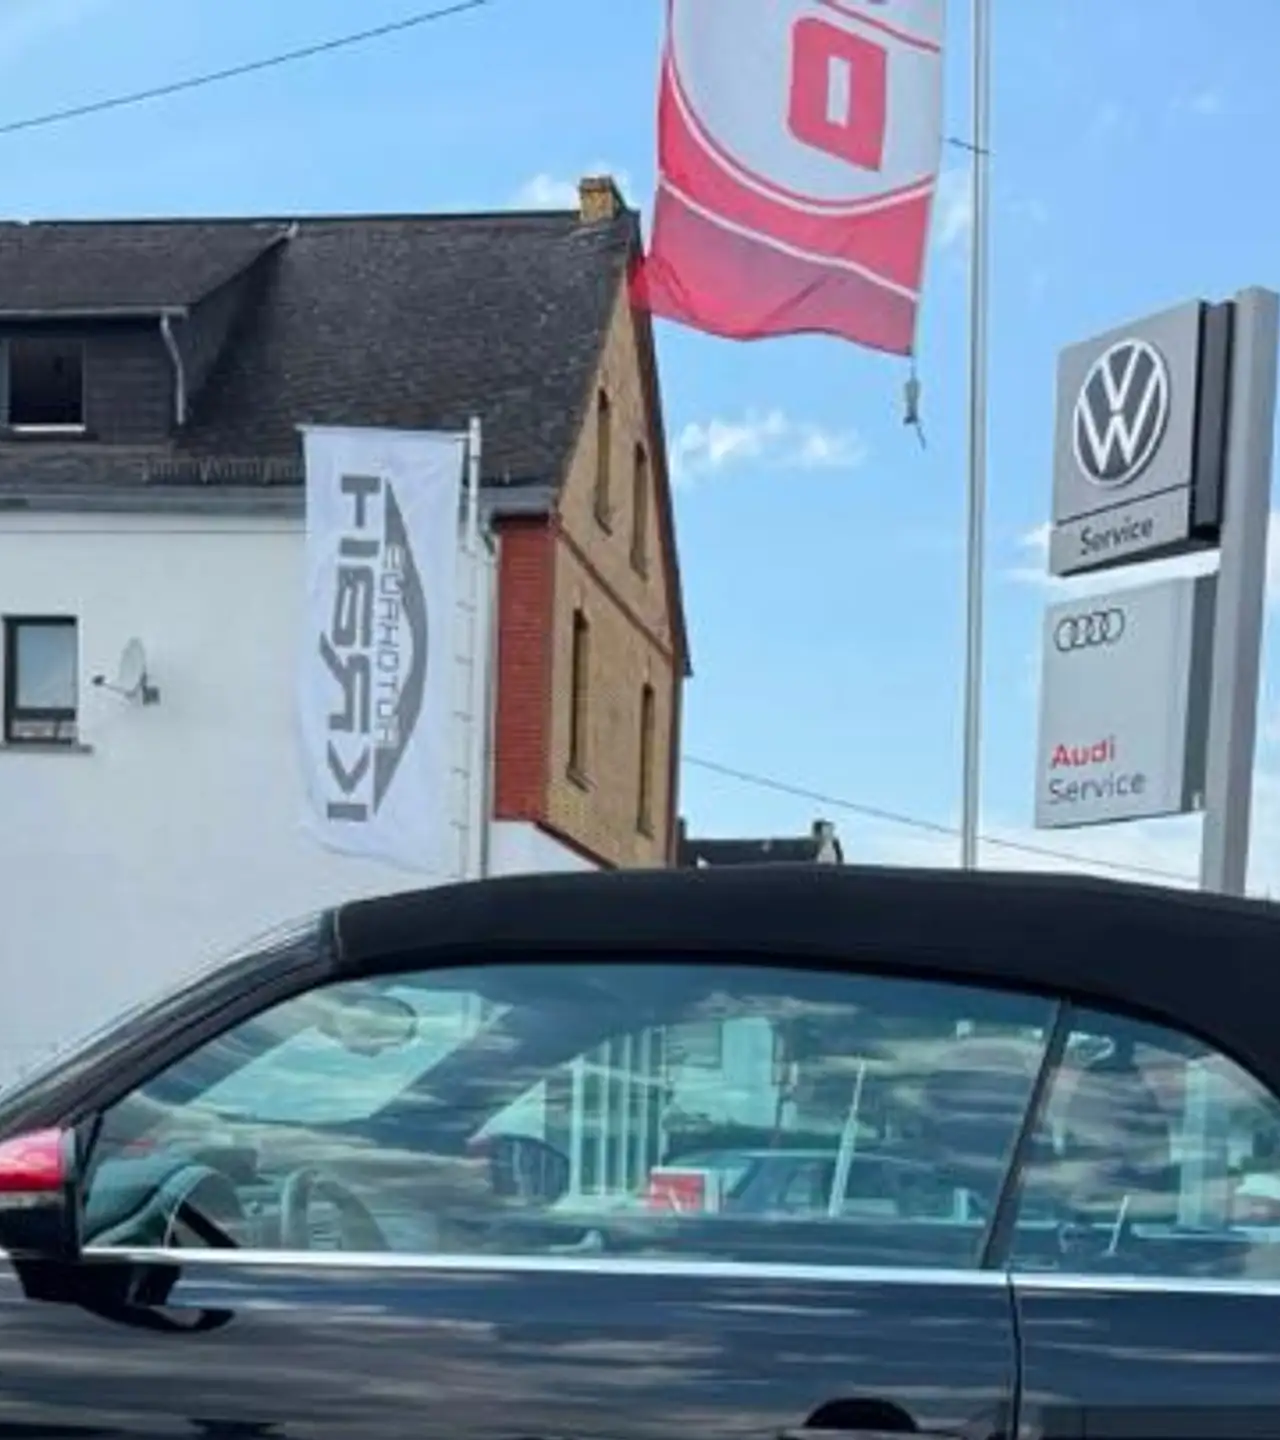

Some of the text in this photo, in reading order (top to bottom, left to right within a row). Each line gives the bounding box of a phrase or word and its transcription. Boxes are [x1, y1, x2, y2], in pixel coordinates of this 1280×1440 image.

[1080, 514, 1154, 556] Service
[1050, 737, 1116, 769] Audi
[1048, 772, 1147, 806] Service
